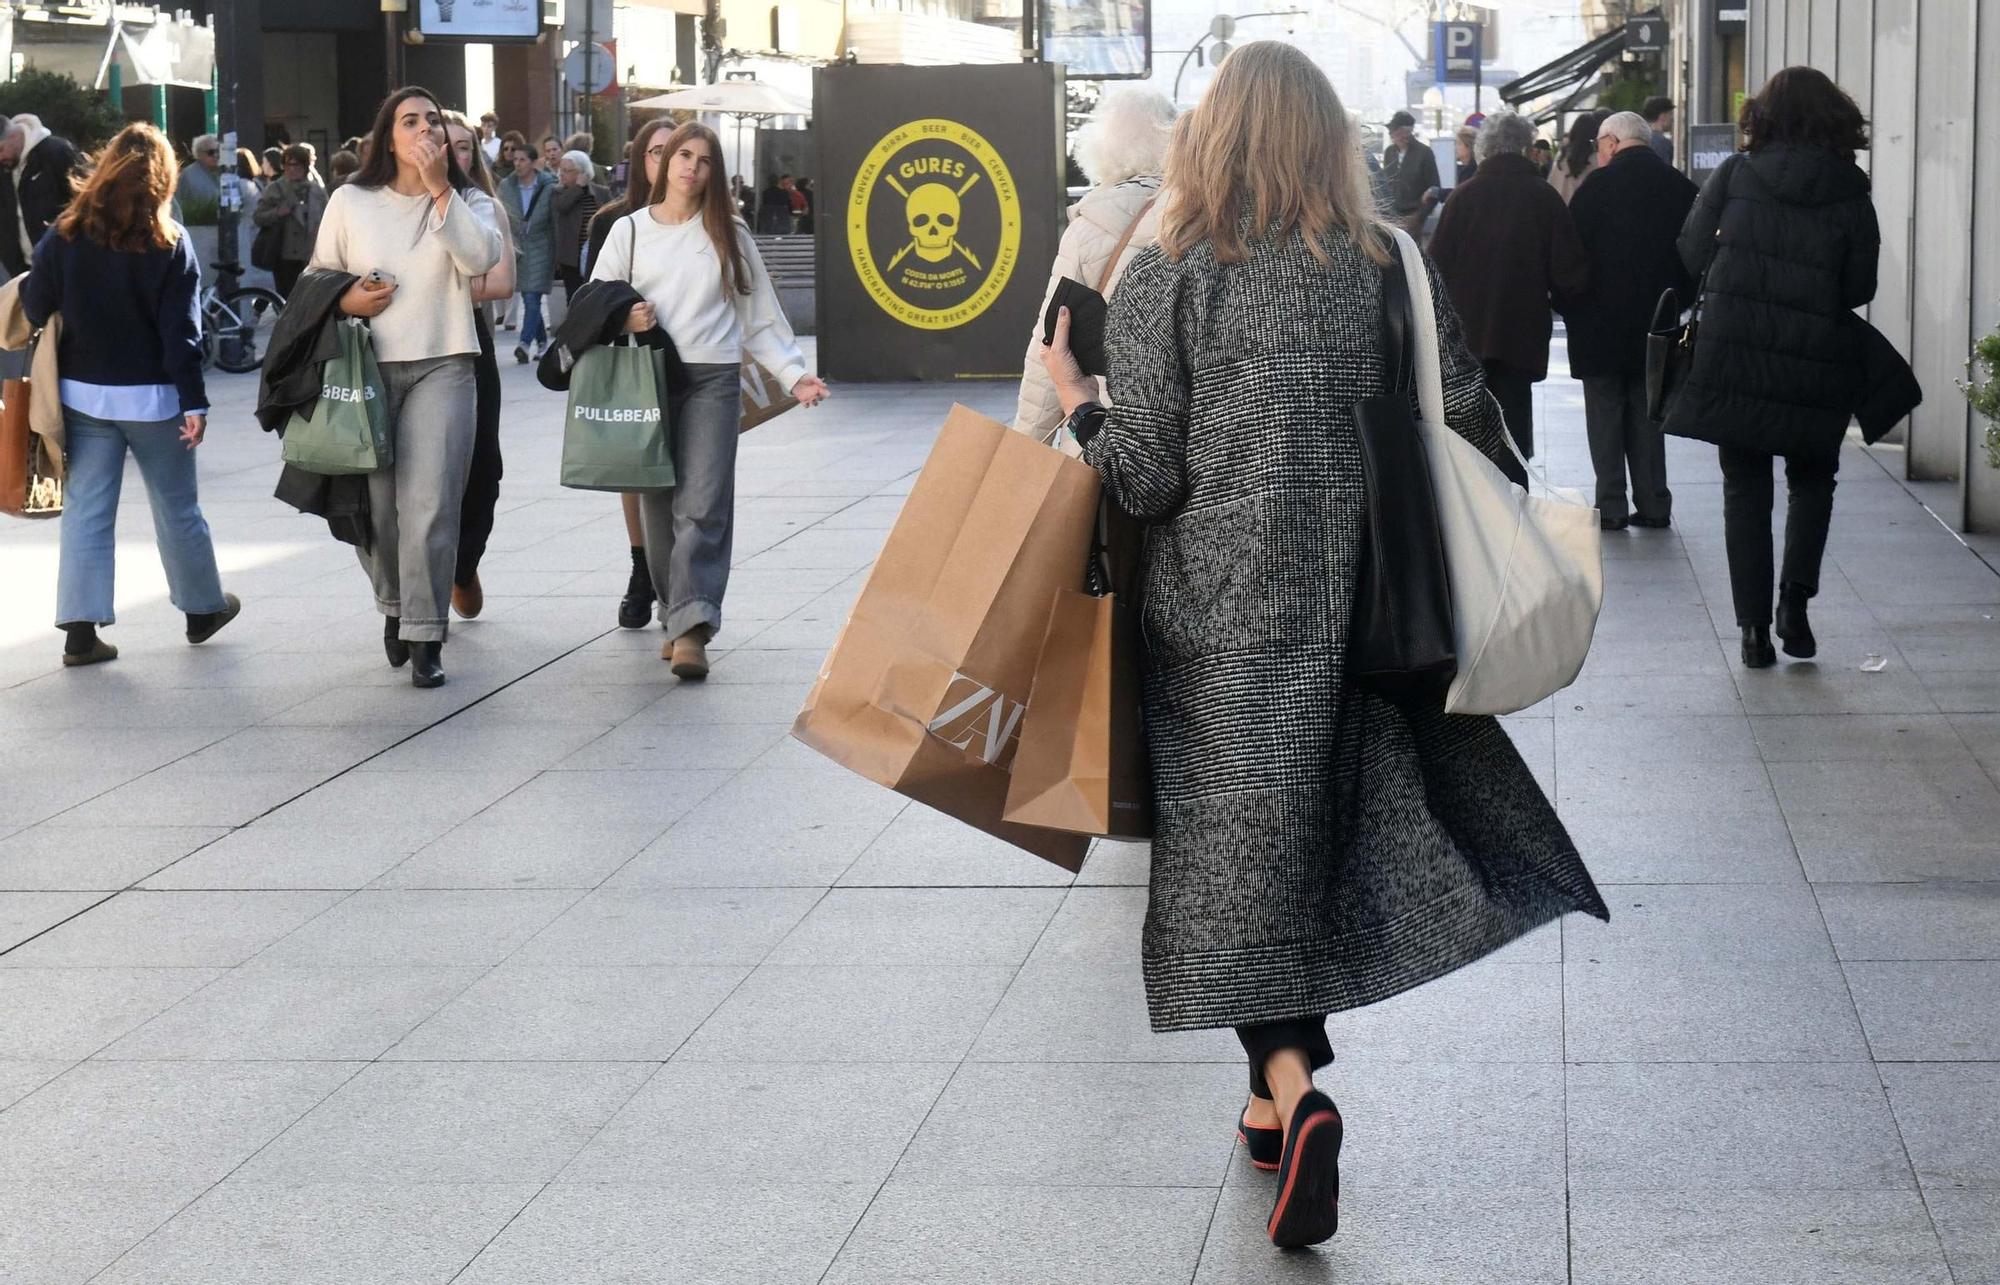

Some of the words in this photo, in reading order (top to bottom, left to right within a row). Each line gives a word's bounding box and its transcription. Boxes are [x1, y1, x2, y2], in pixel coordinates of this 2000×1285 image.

[1447, 27, 1473, 58] P
[855, 163, 876, 206] CERVEZA
[881, 131, 909, 153] BIRRA
[921, 125, 948, 134] BEER
[960, 132, 982, 150] BIER
[899, 157, 966, 179] GURES
[856, 247, 905, 315] HANDCRAFTING
[907, 311, 939, 324] GREAT
[942, 308, 968, 323] BEER
[968, 290, 992, 312] WITH
[990, 246, 1014, 291] RESPECT
[574, 405, 662, 423] PULL&BEAR
